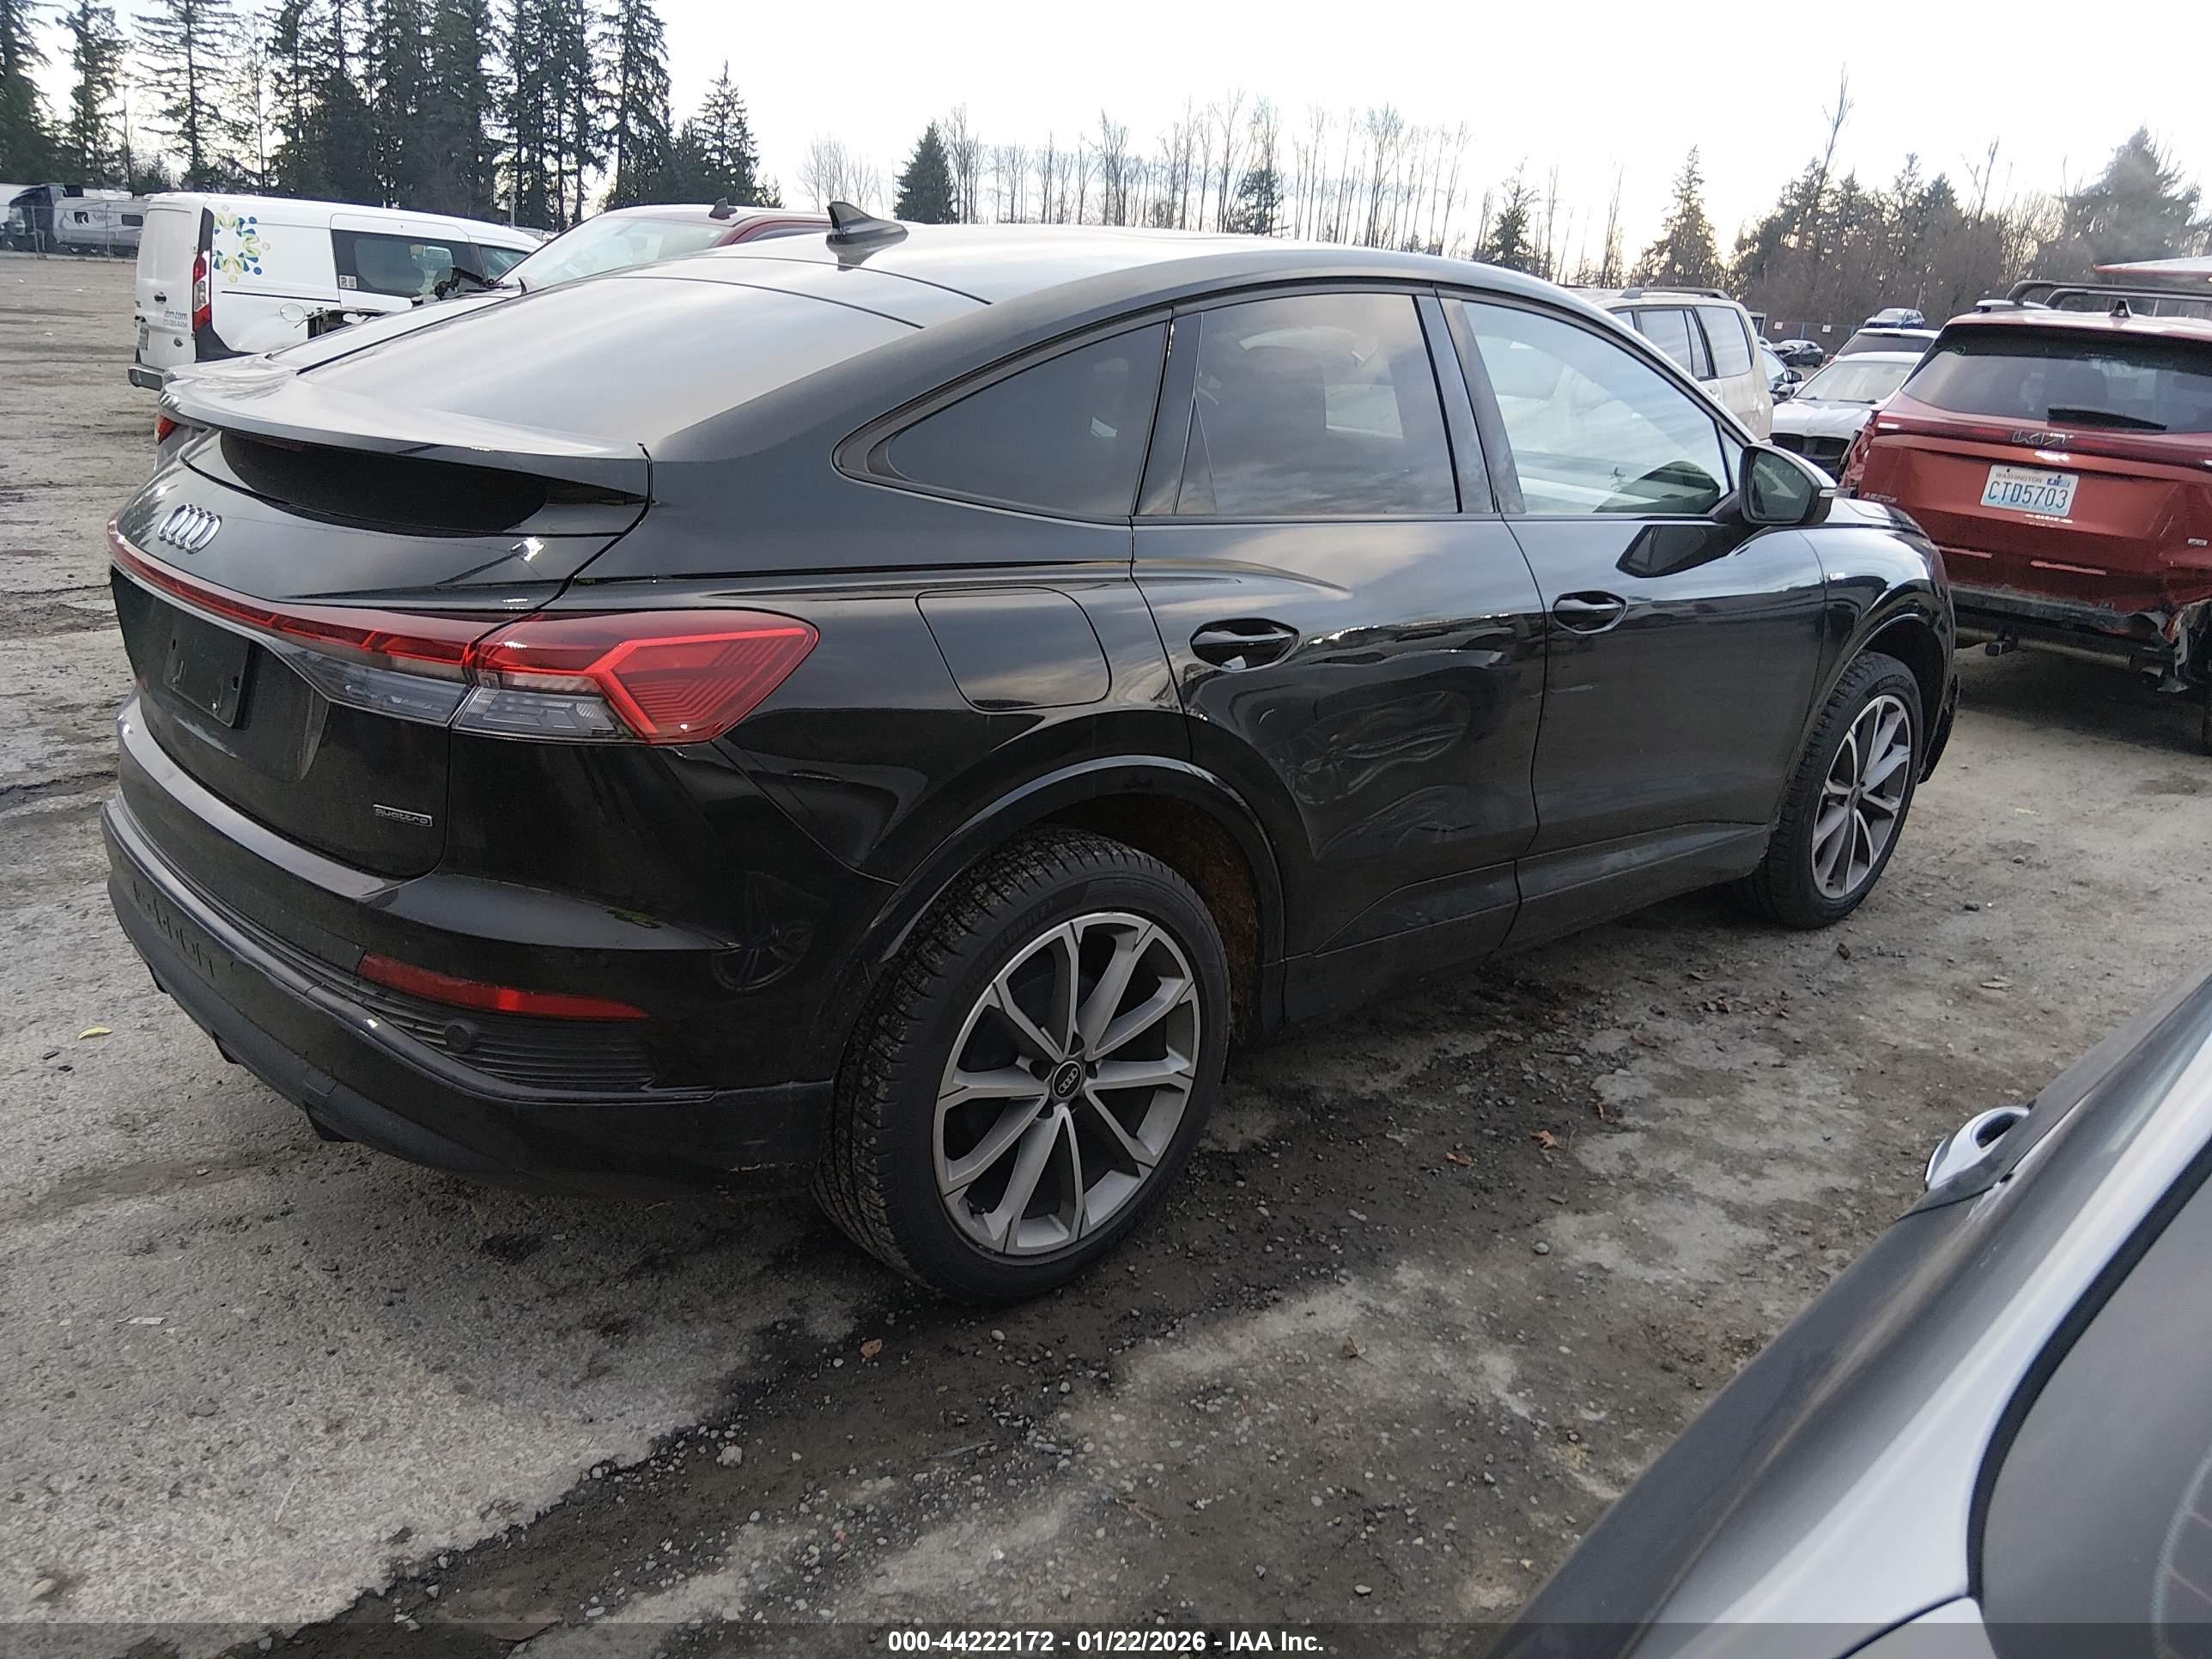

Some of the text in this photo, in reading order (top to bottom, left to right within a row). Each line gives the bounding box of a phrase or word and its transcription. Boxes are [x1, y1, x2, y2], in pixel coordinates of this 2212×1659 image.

[1996, 472, 2042, 483] WASHINGTON
[1987, 480, 2069, 509] CTD5703
[374, 807, 429, 824] quattro
